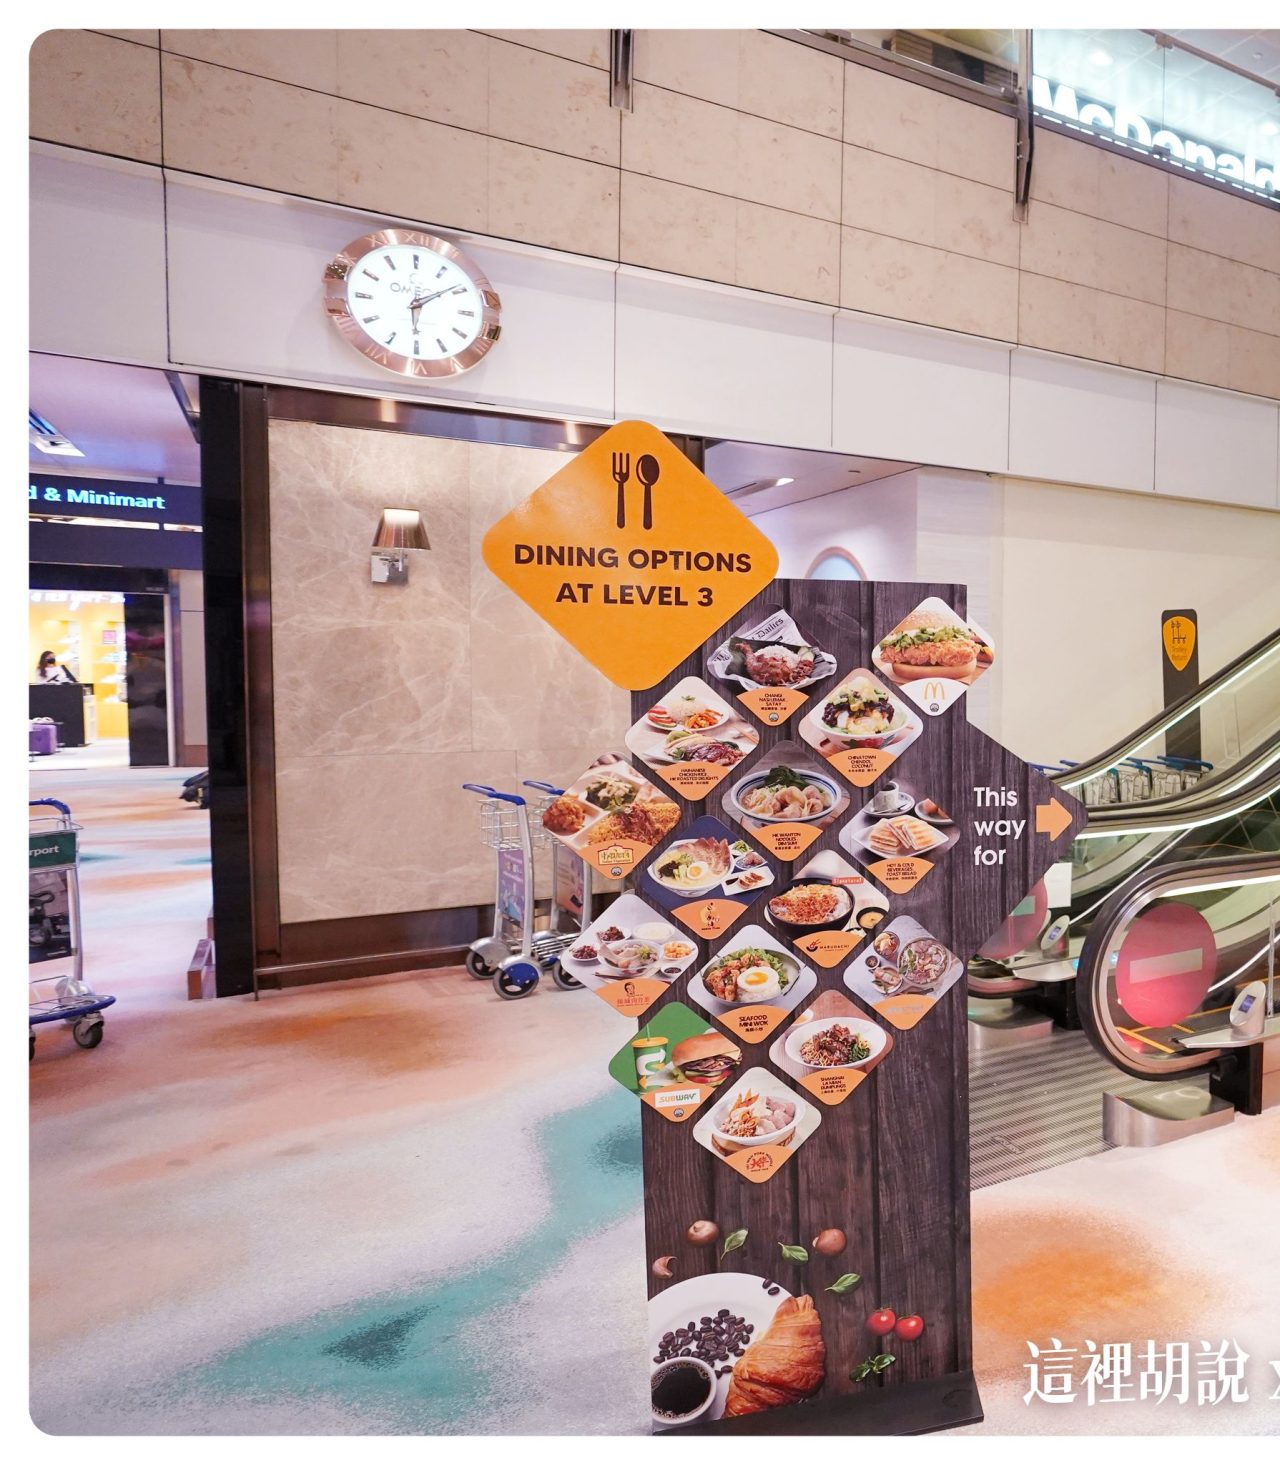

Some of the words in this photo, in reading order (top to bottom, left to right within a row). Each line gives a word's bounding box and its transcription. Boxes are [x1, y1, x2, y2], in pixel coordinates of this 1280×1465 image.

[43, 487, 62, 502] &
[67, 488, 166, 510] Minimart
[514, 543, 619, 569] DINING
[628, 548, 752, 573] OPTIONS
[555, 582, 593, 604] AT
[603, 584, 688, 607] LEVEL
[697, 586, 714, 607] 3
[973, 786, 1018, 807] This
[974, 819, 1026, 840] way
[974, 845, 1006, 866] for
[659, 1092, 697, 1103] SUBWAY
